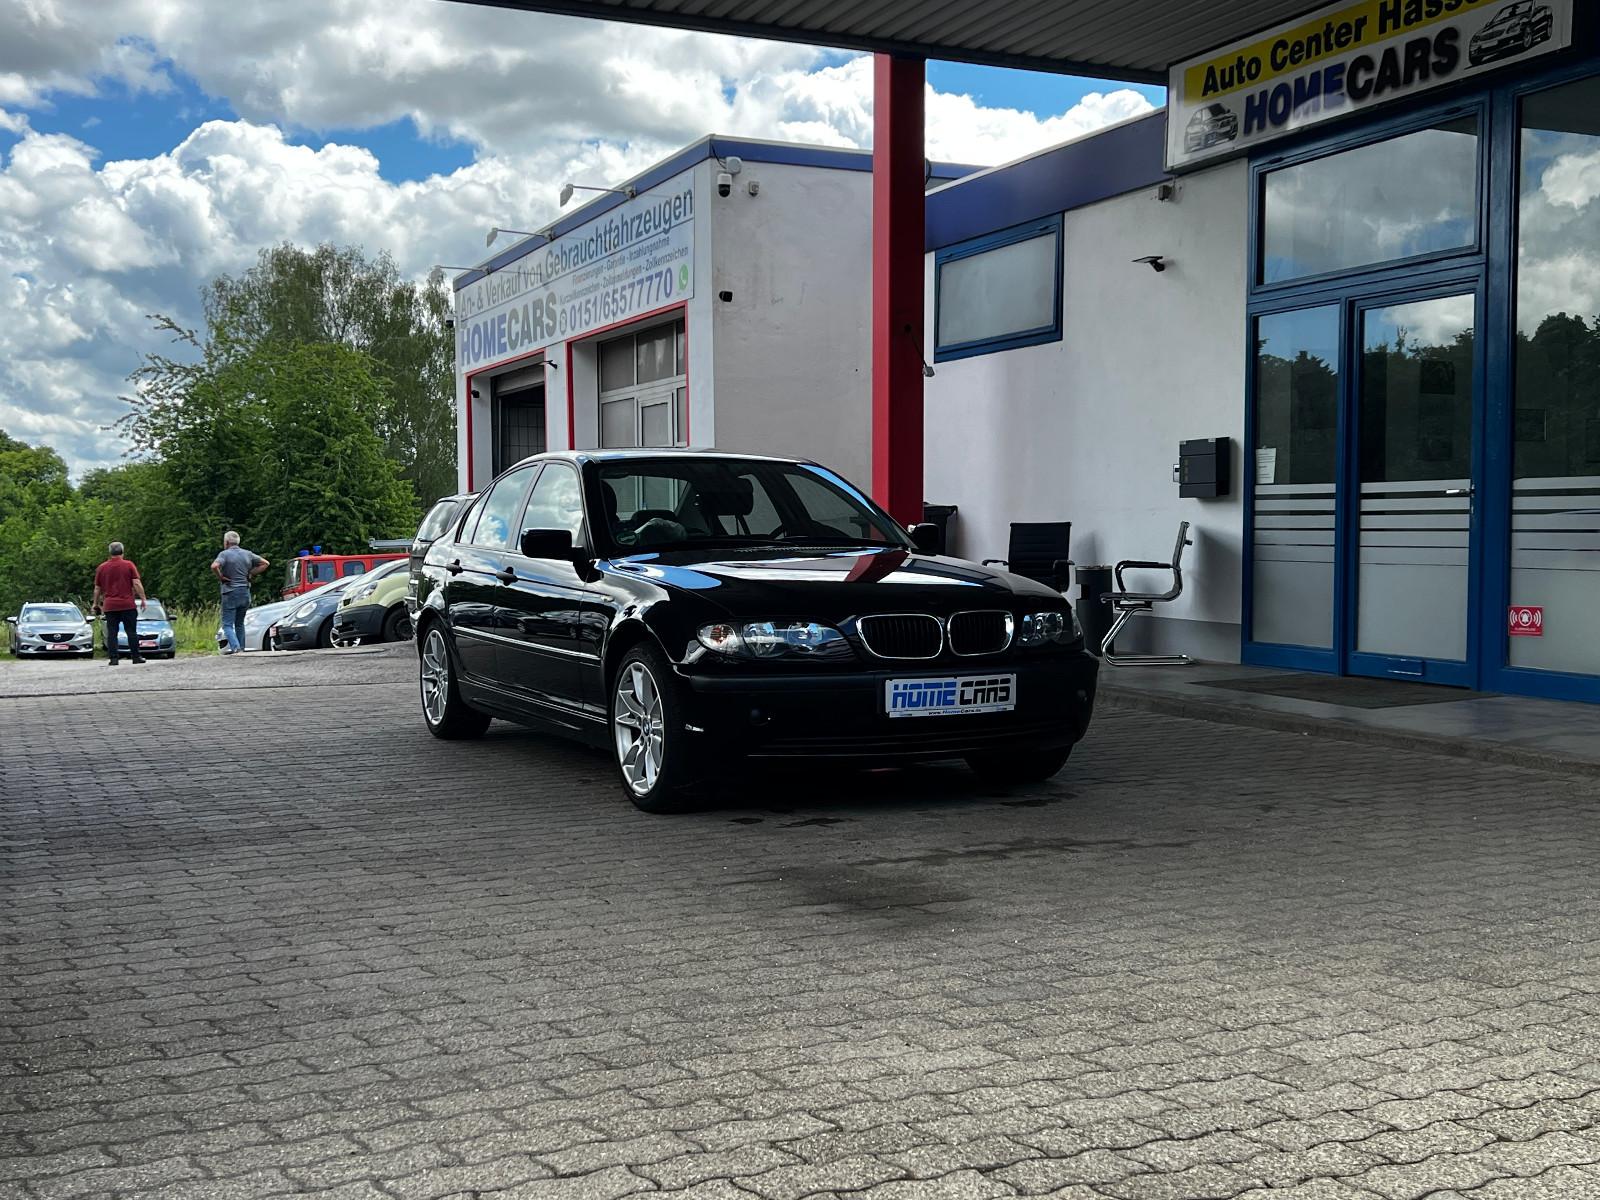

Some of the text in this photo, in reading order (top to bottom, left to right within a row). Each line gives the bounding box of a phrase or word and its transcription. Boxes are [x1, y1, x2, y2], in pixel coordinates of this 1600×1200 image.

[1202, 0, 1481, 97] Auto Center Hass
[1243, 26, 1460, 136] HOMECARS
[486, 266, 521, 307] Verkauf
[523, 263, 542, 289] von
[545, 189, 693, 279] Gebrauchtfahrzeugen
[461, 291, 558, 367] HOMECARS
[569, 267, 673, 329] 0151/65577770
[892, 678, 1011, 708] HOME CARS
